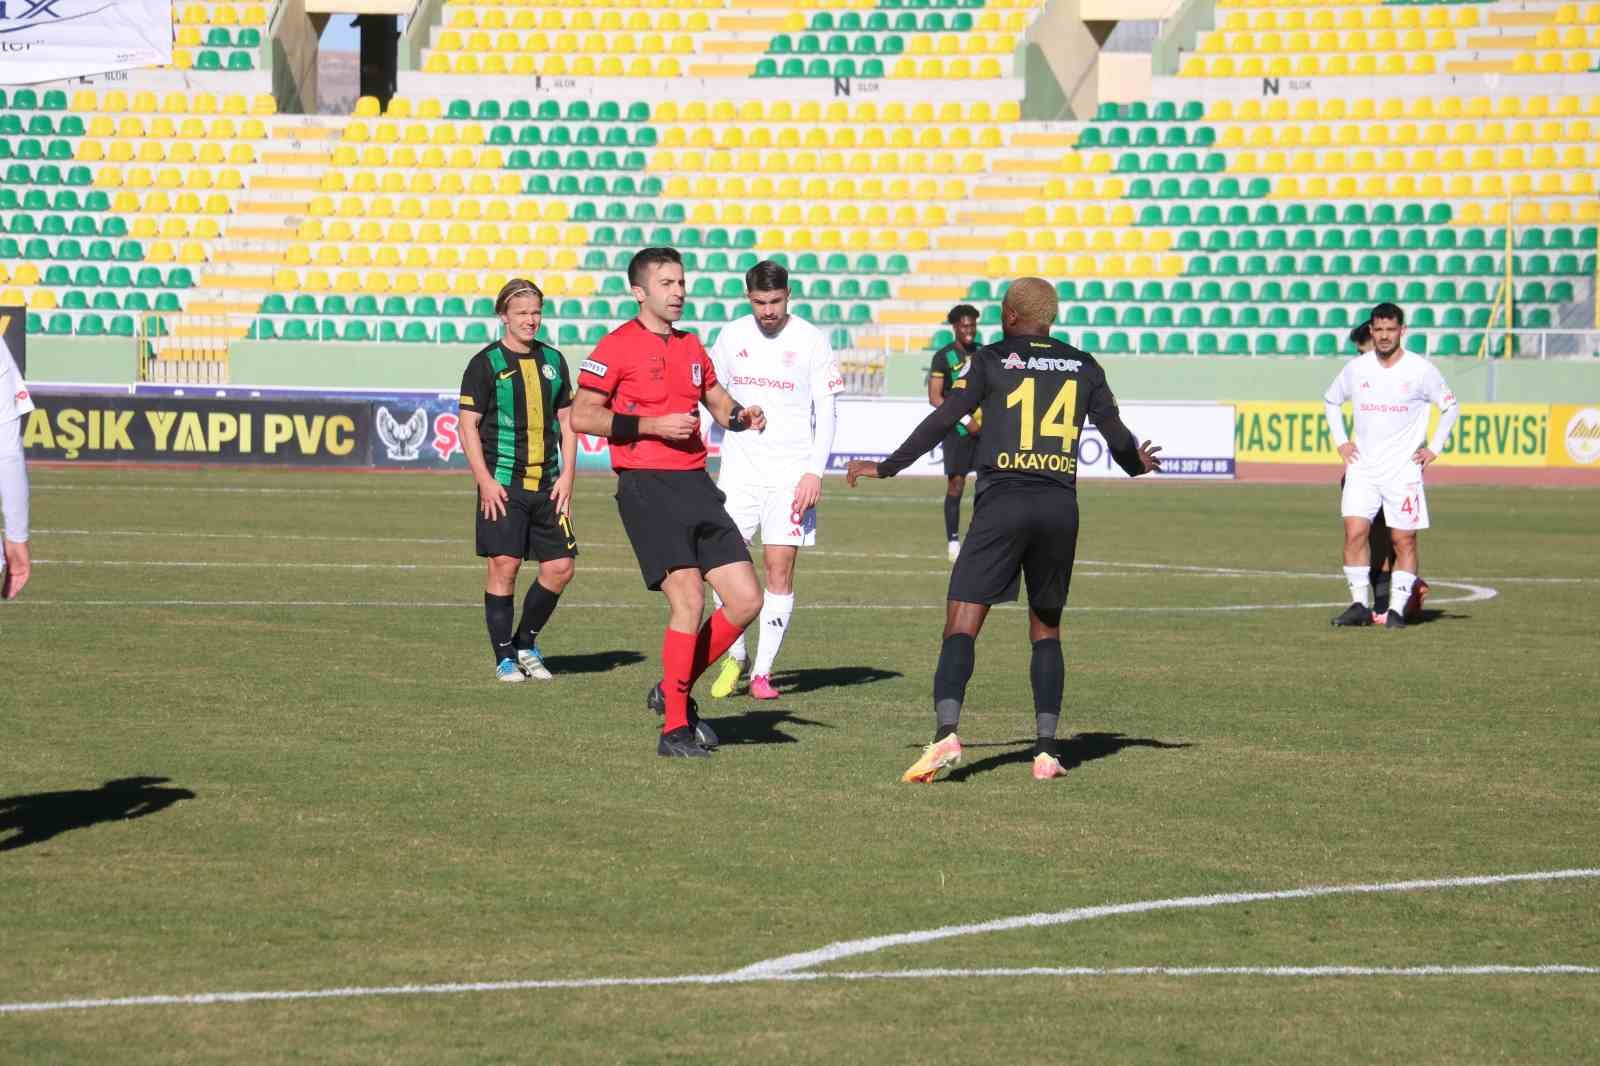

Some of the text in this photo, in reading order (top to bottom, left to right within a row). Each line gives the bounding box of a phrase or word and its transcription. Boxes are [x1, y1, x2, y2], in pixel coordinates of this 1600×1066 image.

[834, 77, 850, 96] N
[1263, 77, 1279, 96] N
[1027, 356, 1081, 372] ASTOR
[1006, 377, 1078, 452] 14
[22, 408, 356, 460] AŞIK YAPI PVC
[997, 452, 1076, 474] O.KAYODE
